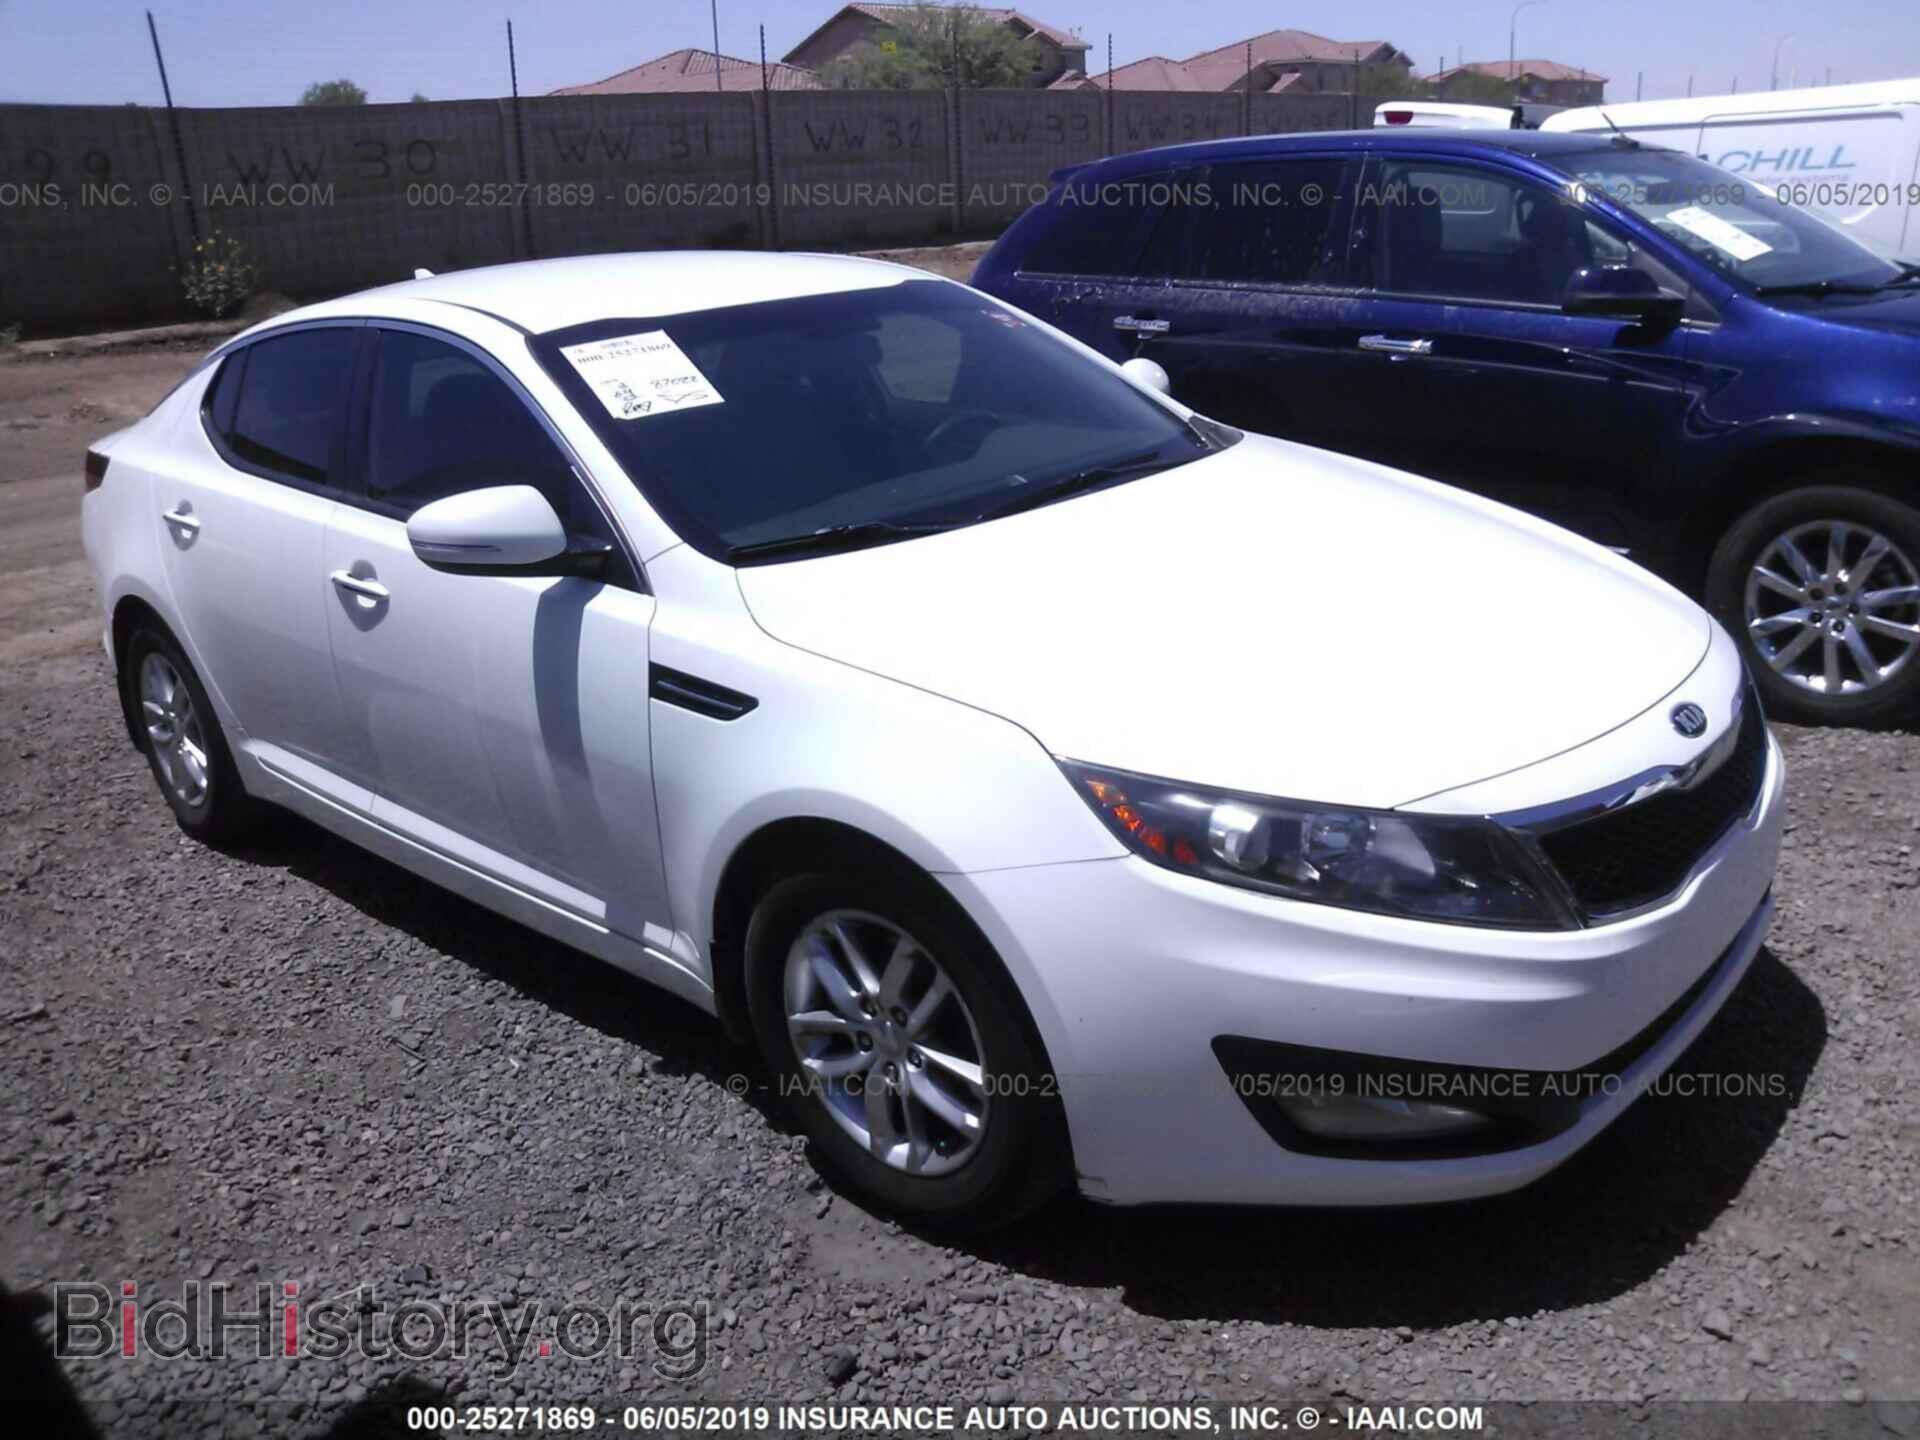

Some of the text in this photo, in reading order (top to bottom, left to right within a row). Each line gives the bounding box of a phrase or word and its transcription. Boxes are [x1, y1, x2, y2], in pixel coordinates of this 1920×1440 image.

[549, 127, 636, 163] WW
[804, 118, 868, 153] WW
[226, 138, 438, 185] WW 30
